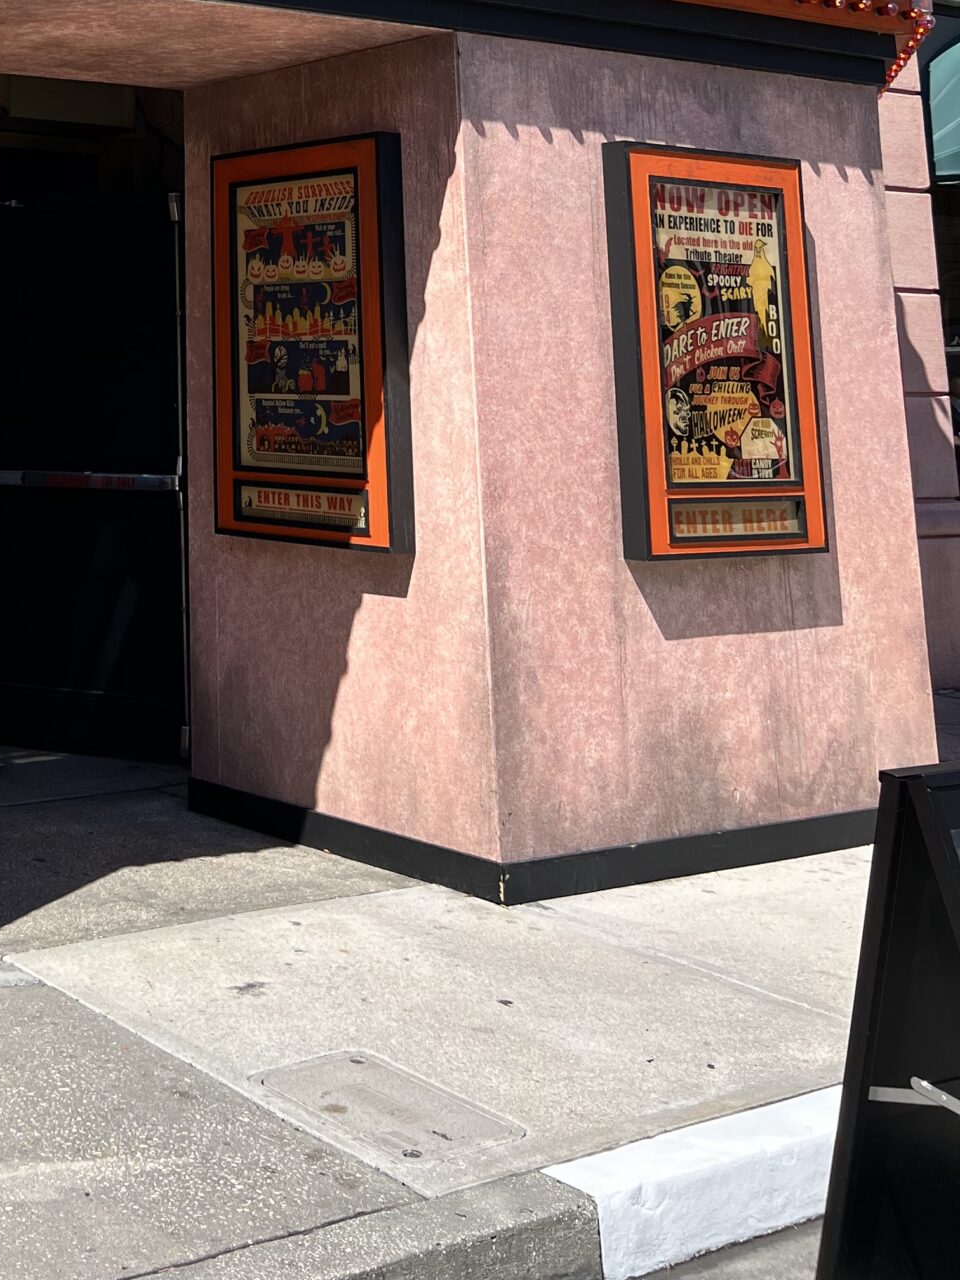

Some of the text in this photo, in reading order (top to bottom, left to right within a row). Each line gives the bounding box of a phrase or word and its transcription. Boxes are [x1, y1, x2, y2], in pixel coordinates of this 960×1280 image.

[245, 180, 354, 206] GHOULISH SURPRISES
[654, 185, 774, 220] NOW OPEN
[247, 195, 355, 219] AWAIT YOU INSIDE
[668, 214, 721, 234] EXPERIENCE
[724, 219, 735, 235] TO
[738, 220, 753, 237] DIE
[756, 222, 774, 238] FOR
[674, 234, 753, 251] Located here in the old
[685, 247, 743, 264] Tribute Theater
[707, 273, 742, 288] SPOOKY
[721, 286, 752, 302] SCARY
[663, 317, 750, 368] DARE to ENTER
[694, 344, 724, 365] Chicken
[707, 366, 741, 381] JOIN US
[689, 382, 751, 394] FOR A CHILLING
[692, 395, 749, 406] JOURNEY THROUGH
[692, 407, 748, 439] HALLOWEEN!
[673, 467, 718, 479] FOR ALL AGES
[257, 490, 353, 512] ENTER THIS WAY
[674, 508, 788, 534] ENTER HERE
